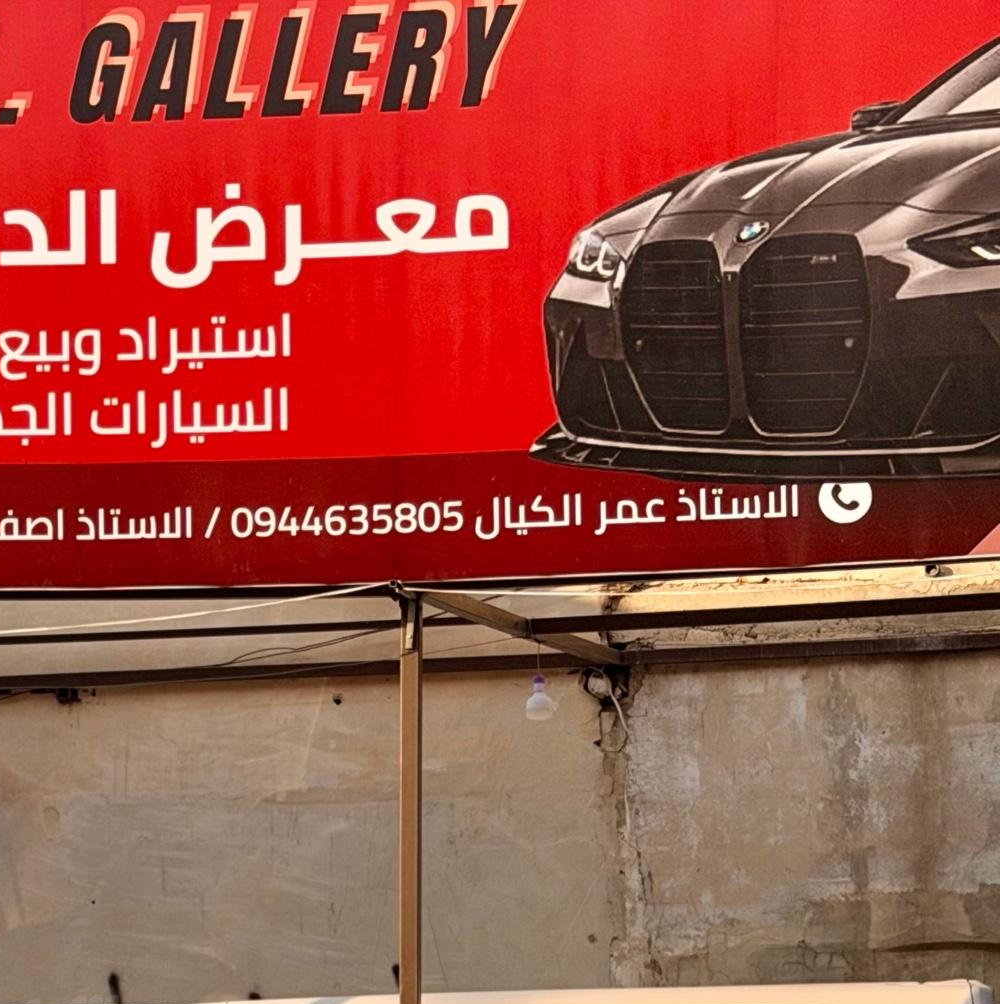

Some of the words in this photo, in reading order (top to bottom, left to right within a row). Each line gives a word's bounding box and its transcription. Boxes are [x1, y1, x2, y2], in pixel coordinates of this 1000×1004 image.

[69, 5, 517, 124] GALLERY
[150, 182, 509, 289] معرض
[116, 312, 291, 374] استيراد
[90, 387, 288, 449] السيارات
[75, 506, 192, 541] الاستاذ
[230, 500, 464, 538] 0944635805
[474, 493, 582, 540] الكيال
[594, 497, 666, 536] عمر
[676, 484, 799, 522] الاستاذ
